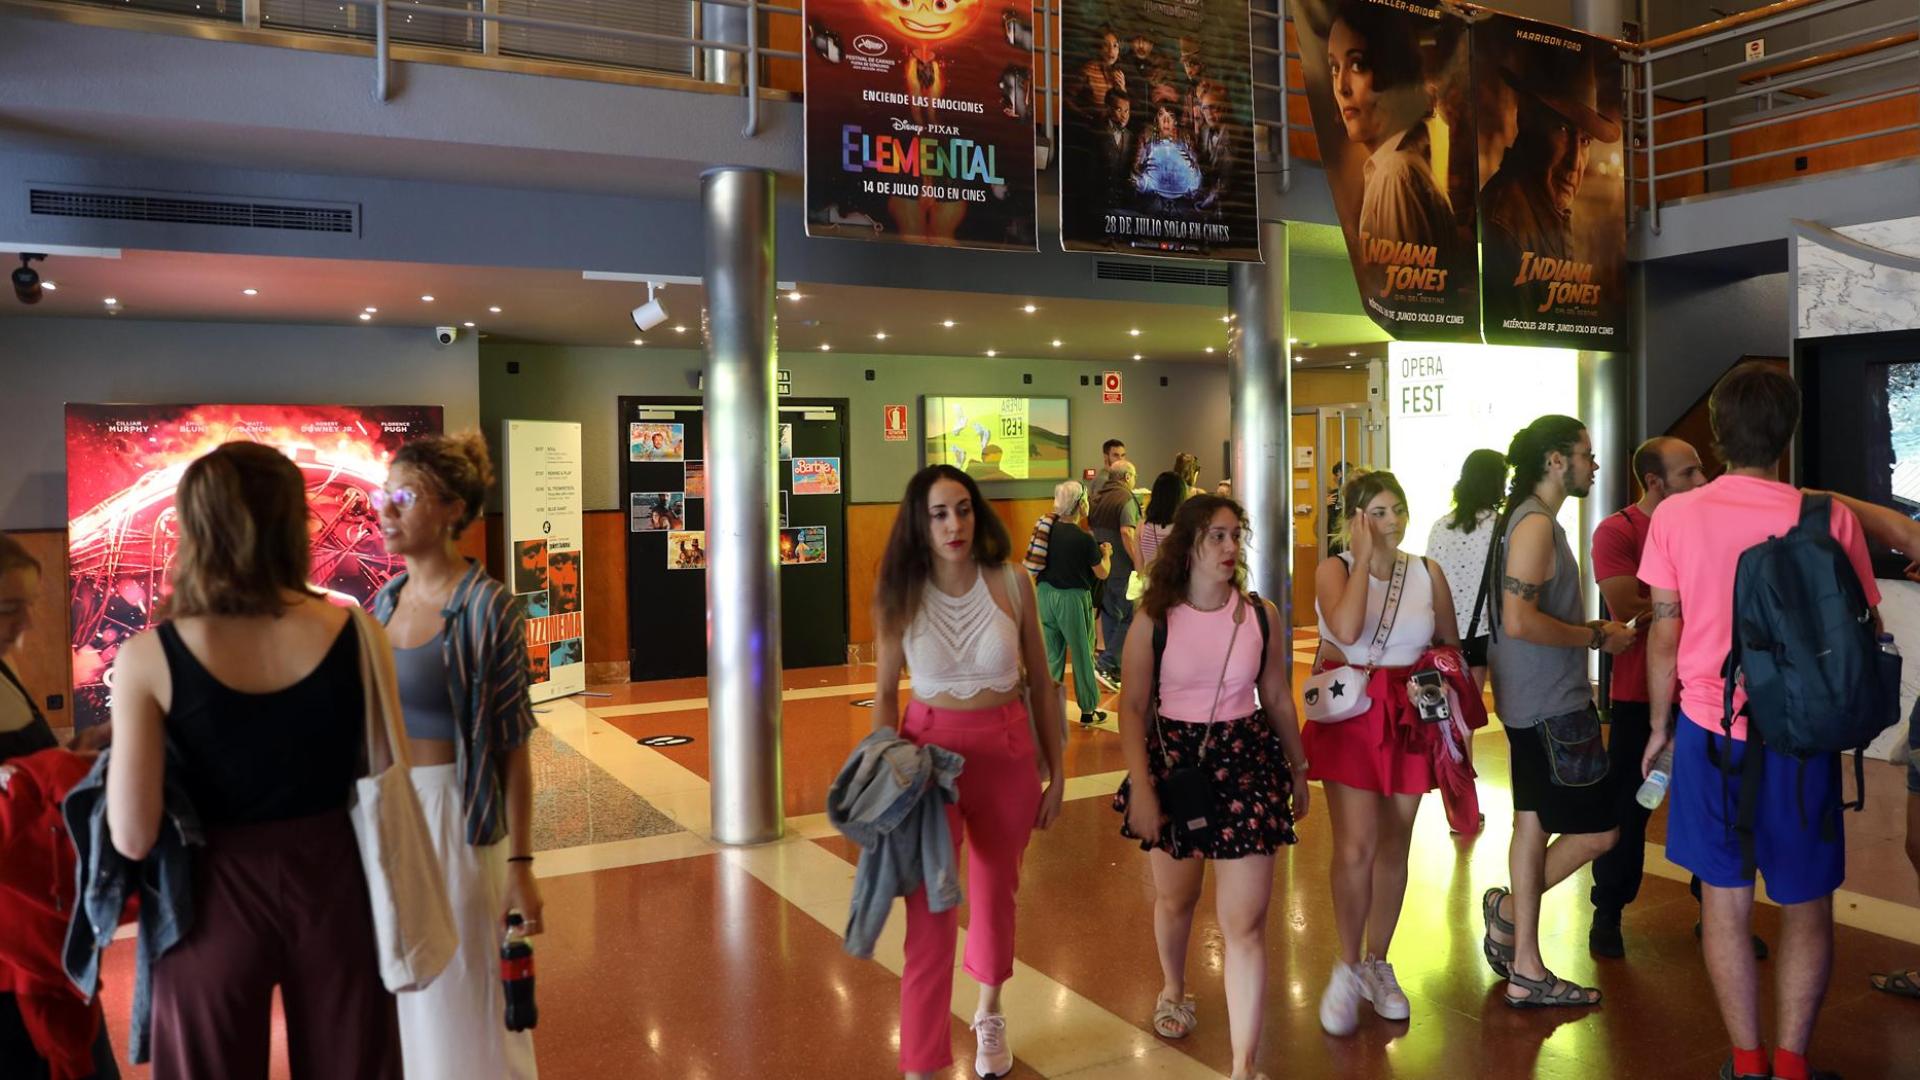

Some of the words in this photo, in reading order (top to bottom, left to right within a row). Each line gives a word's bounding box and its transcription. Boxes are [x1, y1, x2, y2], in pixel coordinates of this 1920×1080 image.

[1368, 0, 1440, 19] ALLER-BRIDGE
[1516, 30, 1561, 46] HARRISON
[1562, 40, 1582, 52] FORD
[863, 90, 909, 105] ENCIENDE
[912, 96, 928, 107] LAS
[932, 98, 984, 113] EMOCIONES
[890, 117, 924, 135] Disney
[928, 124, 960, 136] PIXAR
[842, 124, 1005, 185] ELEMENTAL
[863, 181, 874, 193] 14
[877, 182, 890, 194] DE
[892, 184, 918, 196] JULIO
[921, 186, 945, 199] SOLO
[947, 188, 959, 200] EN
[962, 189, 986, 201] CINES
[1105, 215, 1116, 233] 28
[1119, 216, 1132, 235] DE
[1134, 218, 1161, 237] JULIO
[1164, 220, 1187, 238] SOLO
[1189, 222, 1201, 239] EN
[1203, 223, 1230, 241] CINES
[1360, 231, 1438, 268] INDIANA
[1513, 251, 1593, 287] INDIANA
[1380, 265, 1448, 298] JONES
[1536, 281, 1601, 312] JONES
[1396, 311, 1417, 321] JUNIO
[1418, 313, 1435, 322] SOLO
[1436, 314, 1445, 323] EN
[1445, 315, 1464, 324] CINES
[1503, 318, 1536, 330] MIÉRCOLES
[1537, 322, 1547, 330] 28
[1547, 322, 1555, 331] DE
[1556, 323, 1574, 333] JUNIO
[1575, 325, 1589, 333] SOLO
[1590, 326, 1597, 334] EN
[1402, 356, 1443, 378] OPERA
[1402, 384, 1444, 413] FEST
[301, 425, 339, 433] DOWNEY
[794, 459, 832, 474] Barbie
